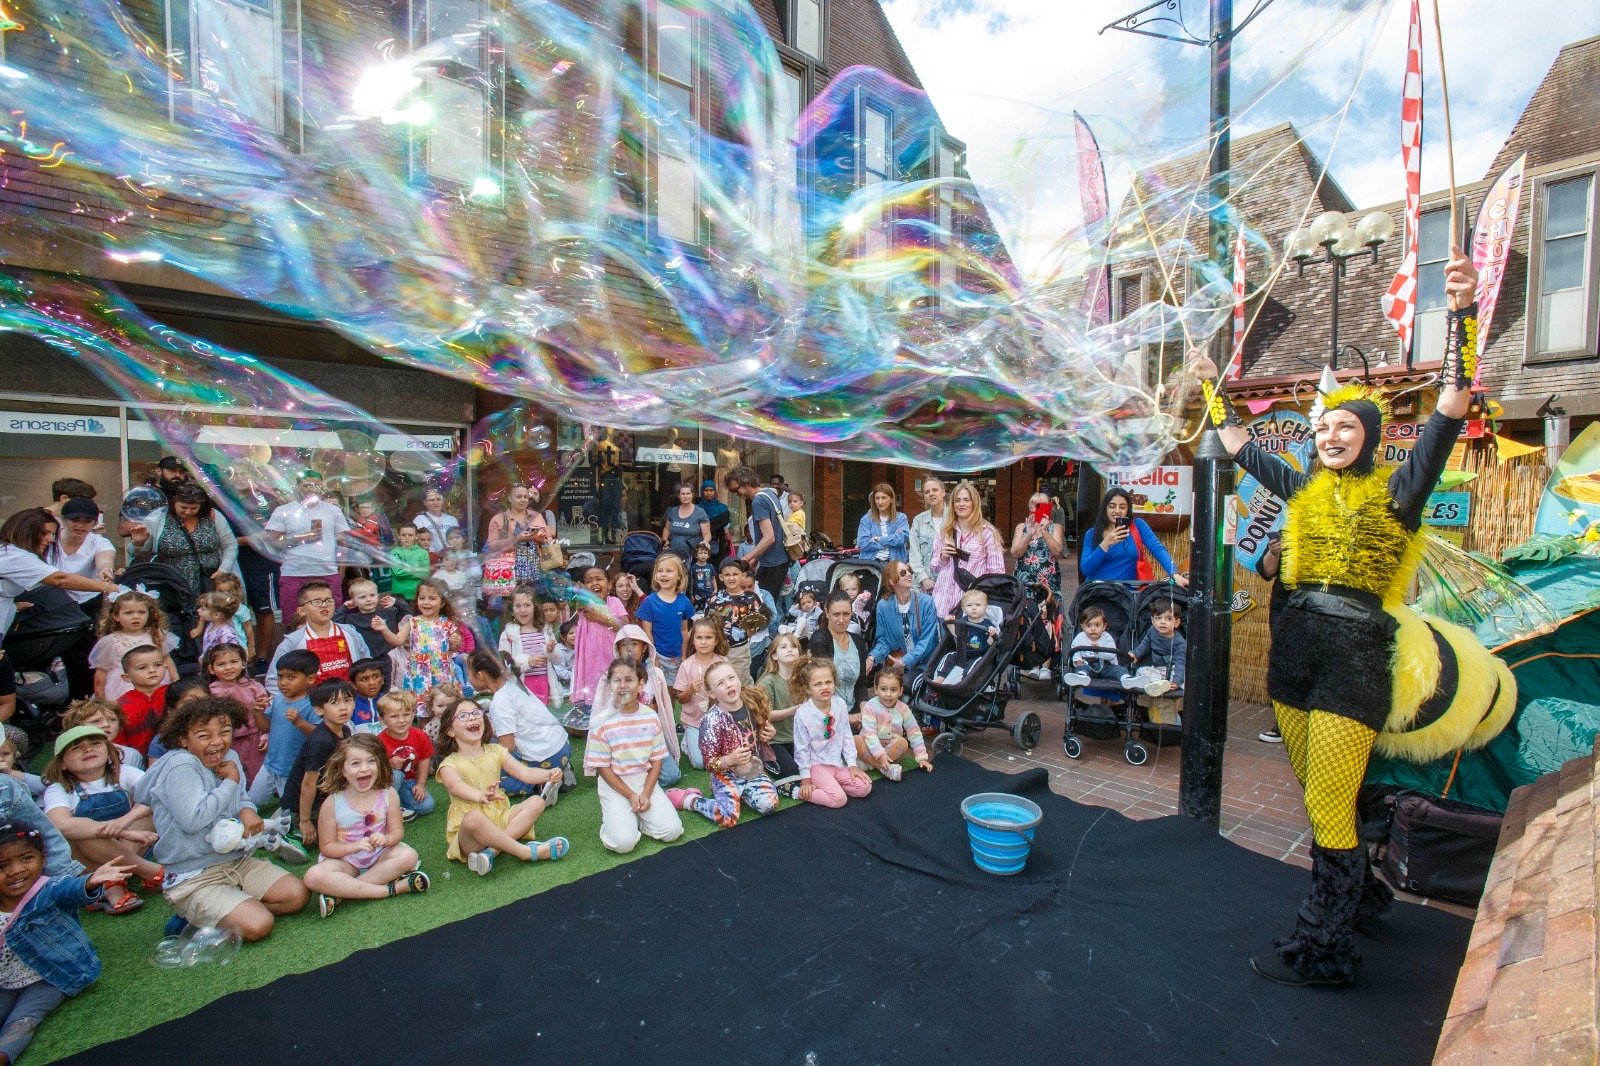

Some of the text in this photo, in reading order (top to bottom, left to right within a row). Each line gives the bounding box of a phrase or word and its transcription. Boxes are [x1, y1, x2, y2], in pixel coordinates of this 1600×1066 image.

[1386, 421, 1468, 437] COFE
[1259, 439, 1290, 452] HUT
[1238, 490, 1282, 554] DONU
